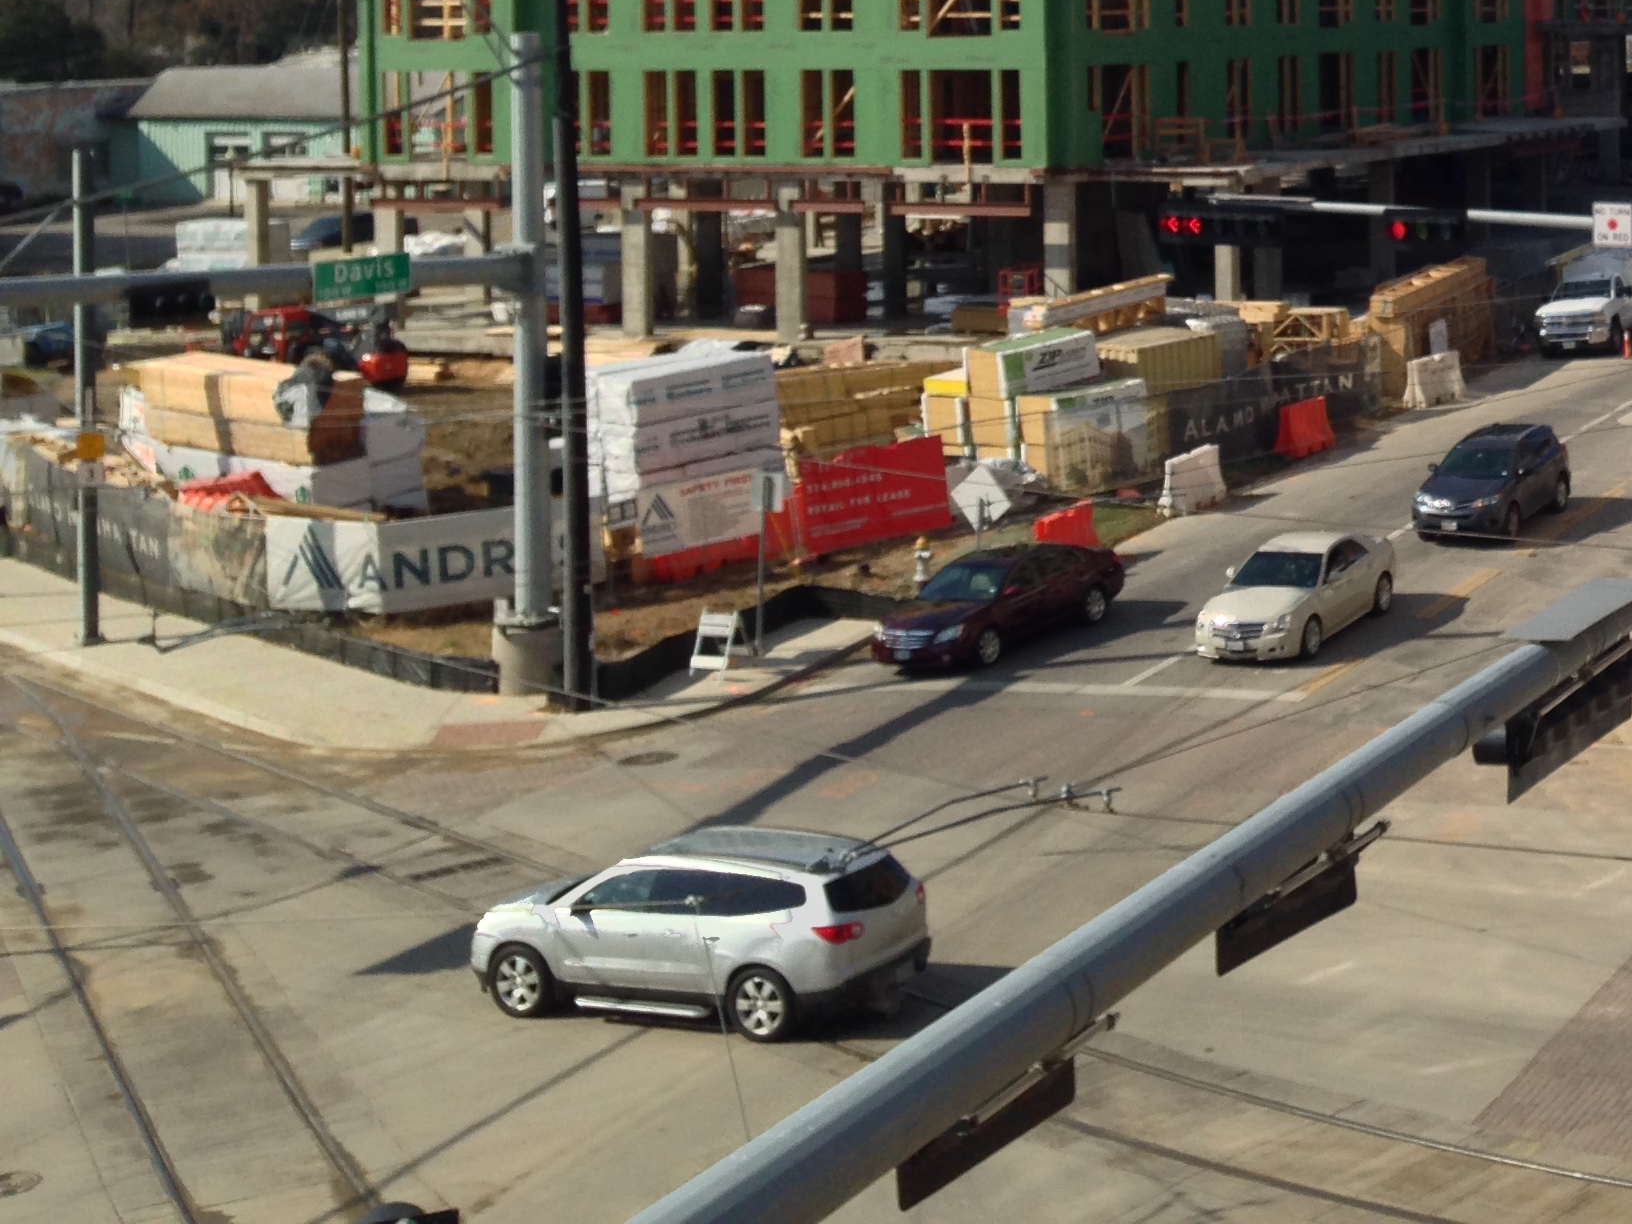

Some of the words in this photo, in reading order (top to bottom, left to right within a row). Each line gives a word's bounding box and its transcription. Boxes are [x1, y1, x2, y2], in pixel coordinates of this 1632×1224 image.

[1613, 232, 1630, 242] RED
[334, 259, 394, 284] Davis
[1037, 348, 1063, 366] ZIP
[1184, 406, 1255, 442] ALAMO
[680, 480, 720, 497] SAFETY
[850, 495, 871, 507] FOR
[877, 488, 912, 503] LEASE
[356, 533, 568, 592] ANDR
